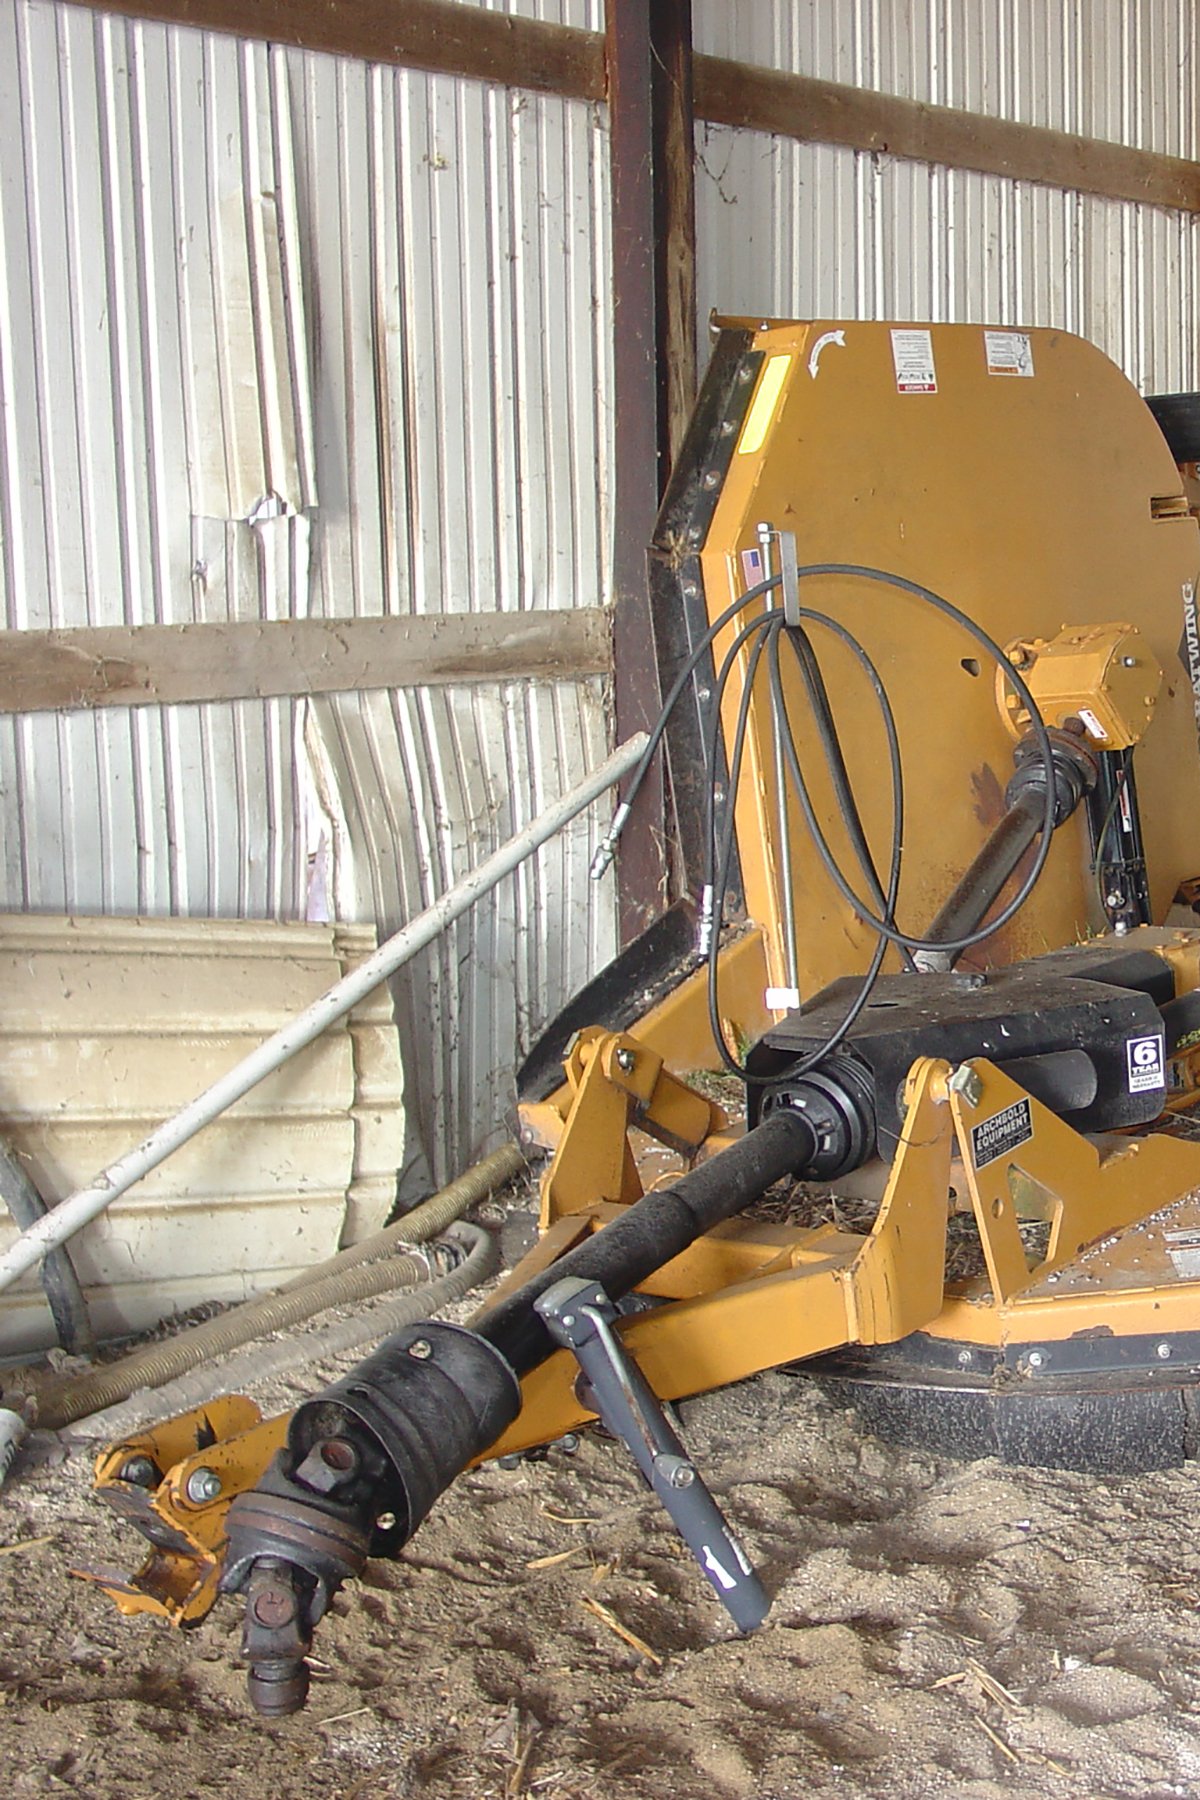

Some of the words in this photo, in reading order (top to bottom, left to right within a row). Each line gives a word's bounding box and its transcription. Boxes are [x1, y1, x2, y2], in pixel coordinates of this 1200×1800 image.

[1133, 1041, 1157, 1065] 6
[976, 1112, 1028, 1151] EQUIPMENT
[977, 1103, 1025, 1138] ARCHBOLD
